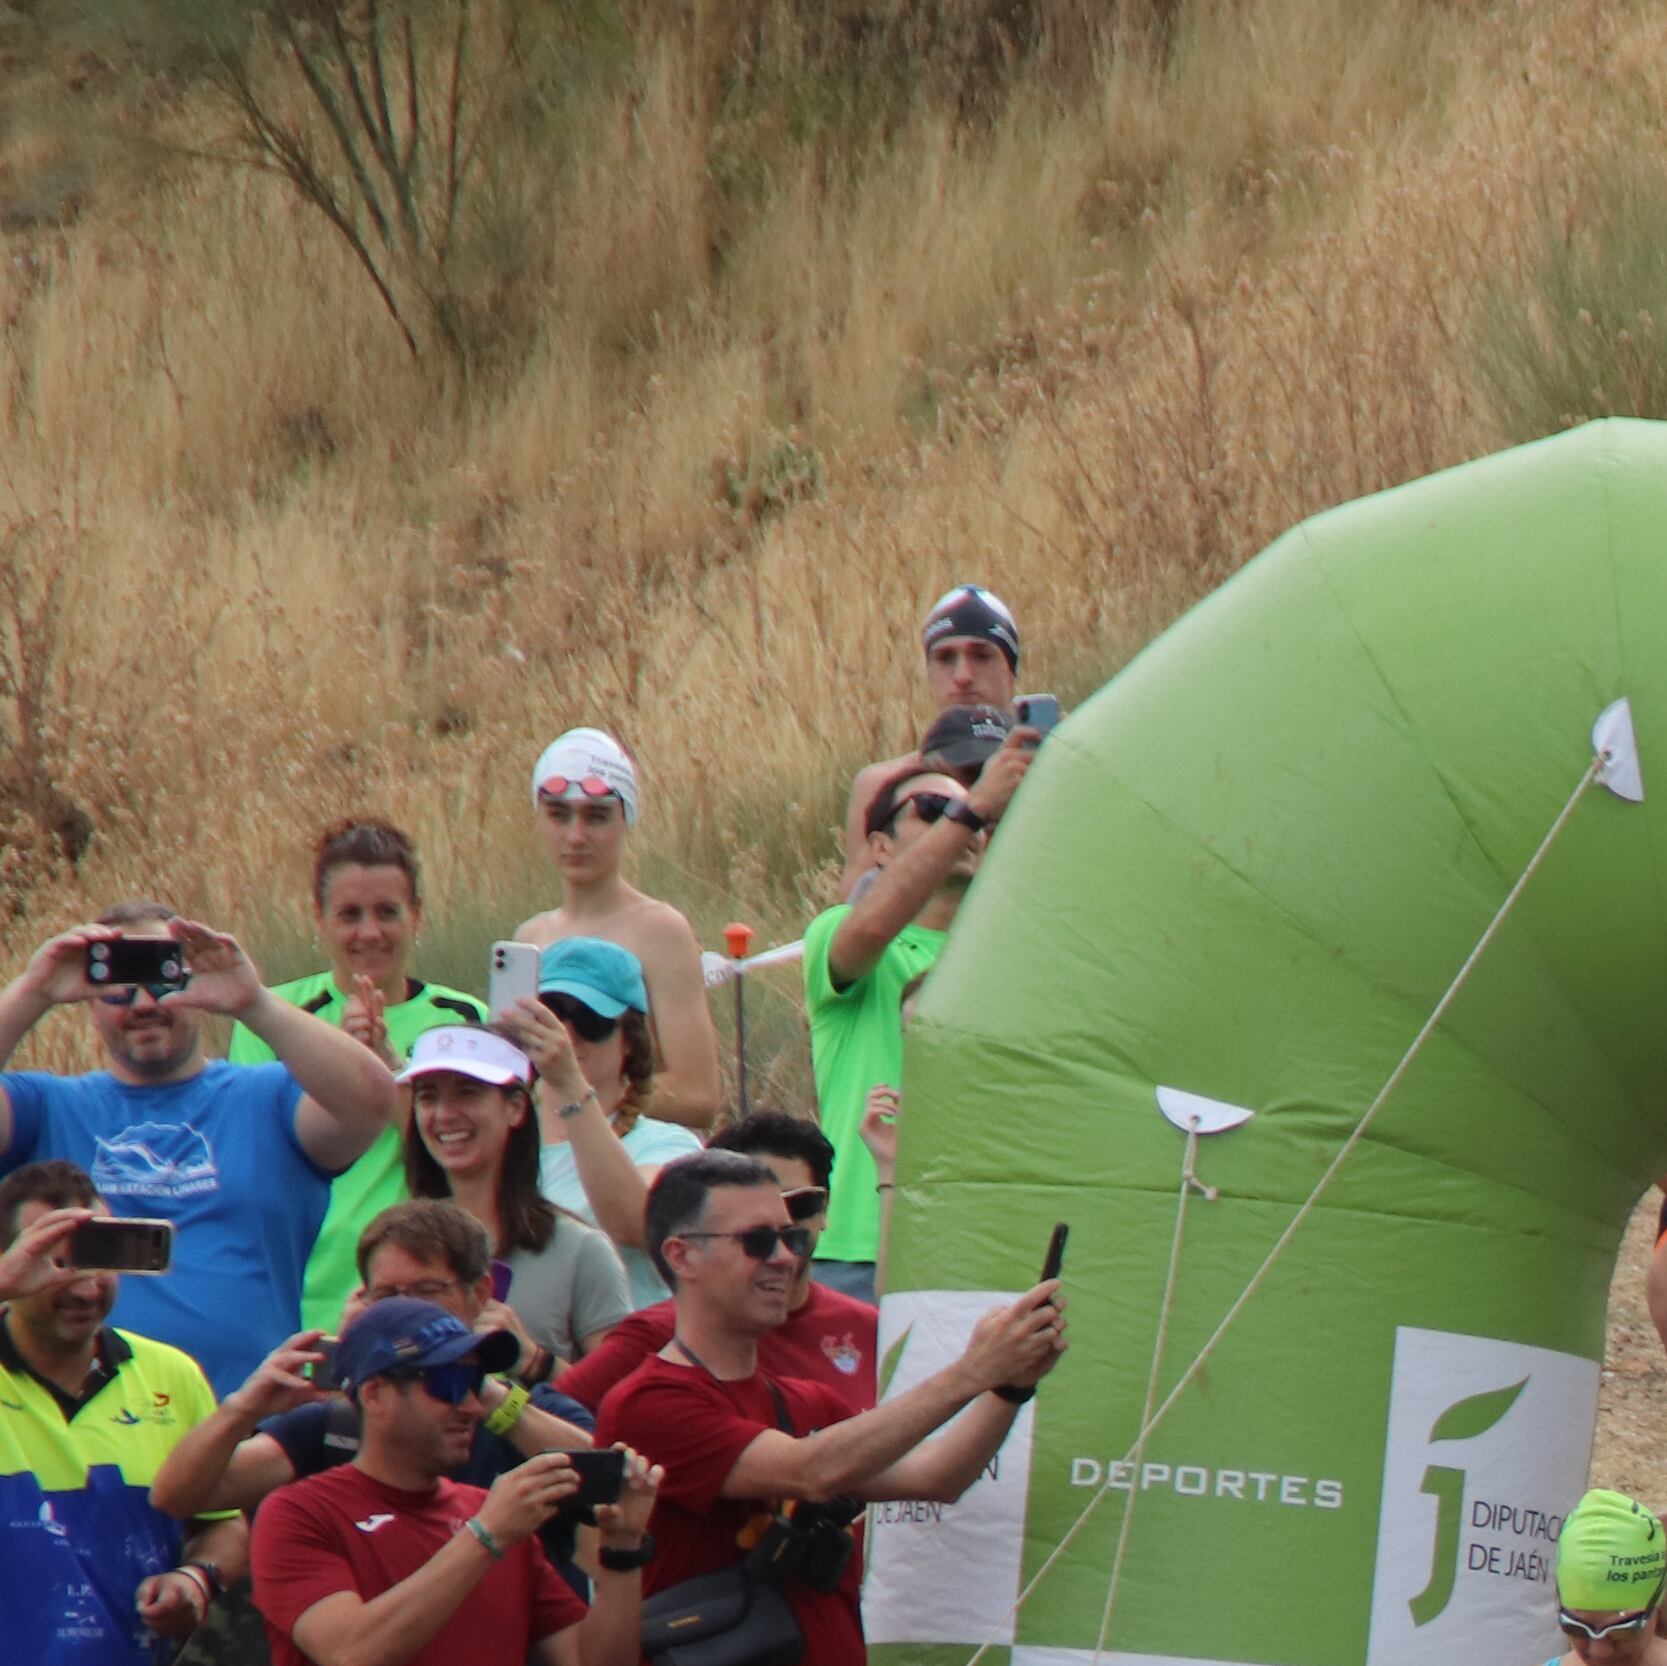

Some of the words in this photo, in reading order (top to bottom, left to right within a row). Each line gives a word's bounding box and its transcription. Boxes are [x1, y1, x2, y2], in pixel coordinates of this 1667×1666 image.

[1070, 1457, 1344, 1510] DEPORTES
[1471, 1500, 1561, 1543] DIPUTAC
[1468, 1543, 1501, 1574] DE
[1504, 1548, 1550, 1583] JAÉN
[1606, 1570, 1629, 1582] los
